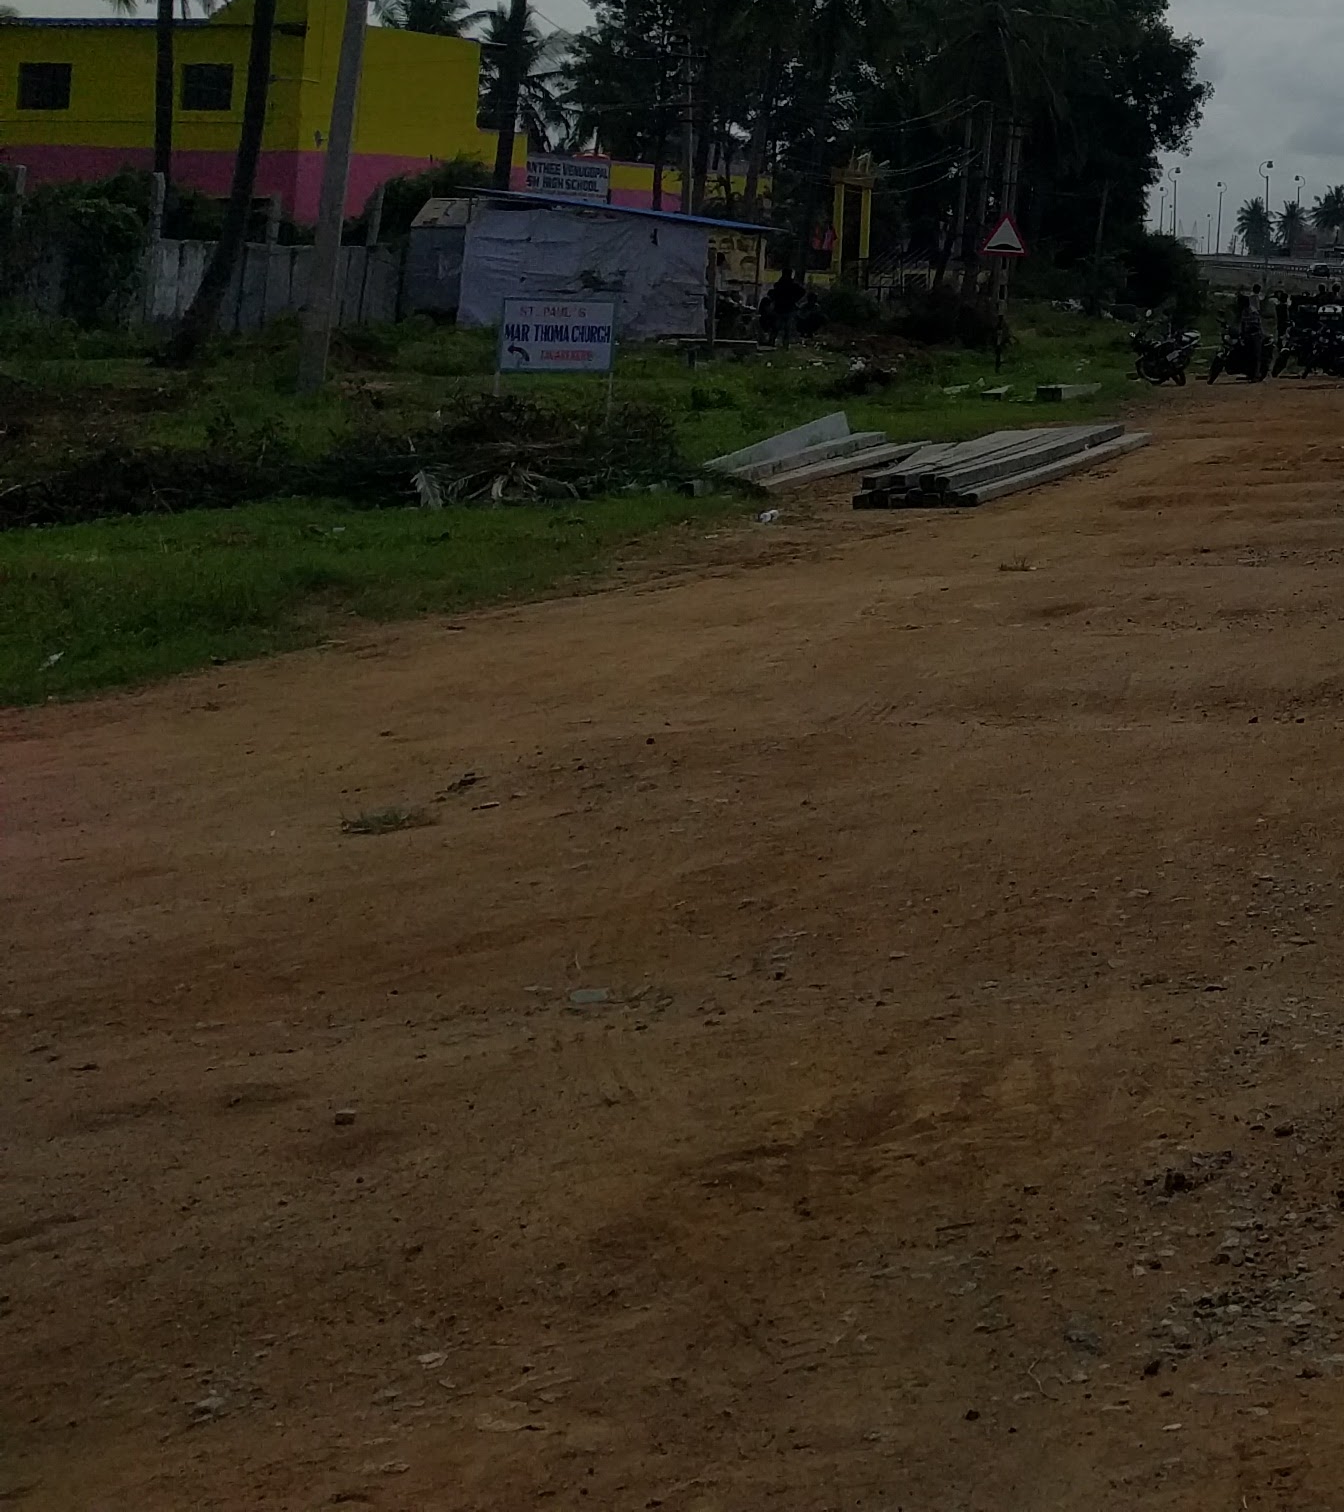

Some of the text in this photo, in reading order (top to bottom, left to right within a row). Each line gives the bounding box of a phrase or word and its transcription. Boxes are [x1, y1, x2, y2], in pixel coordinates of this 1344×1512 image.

[543, 176, 564, 189] HIGH
[565, 178, 600, 192] SCHOOL
[505, 324, 611, 343] MAR THOMA CHURCH
